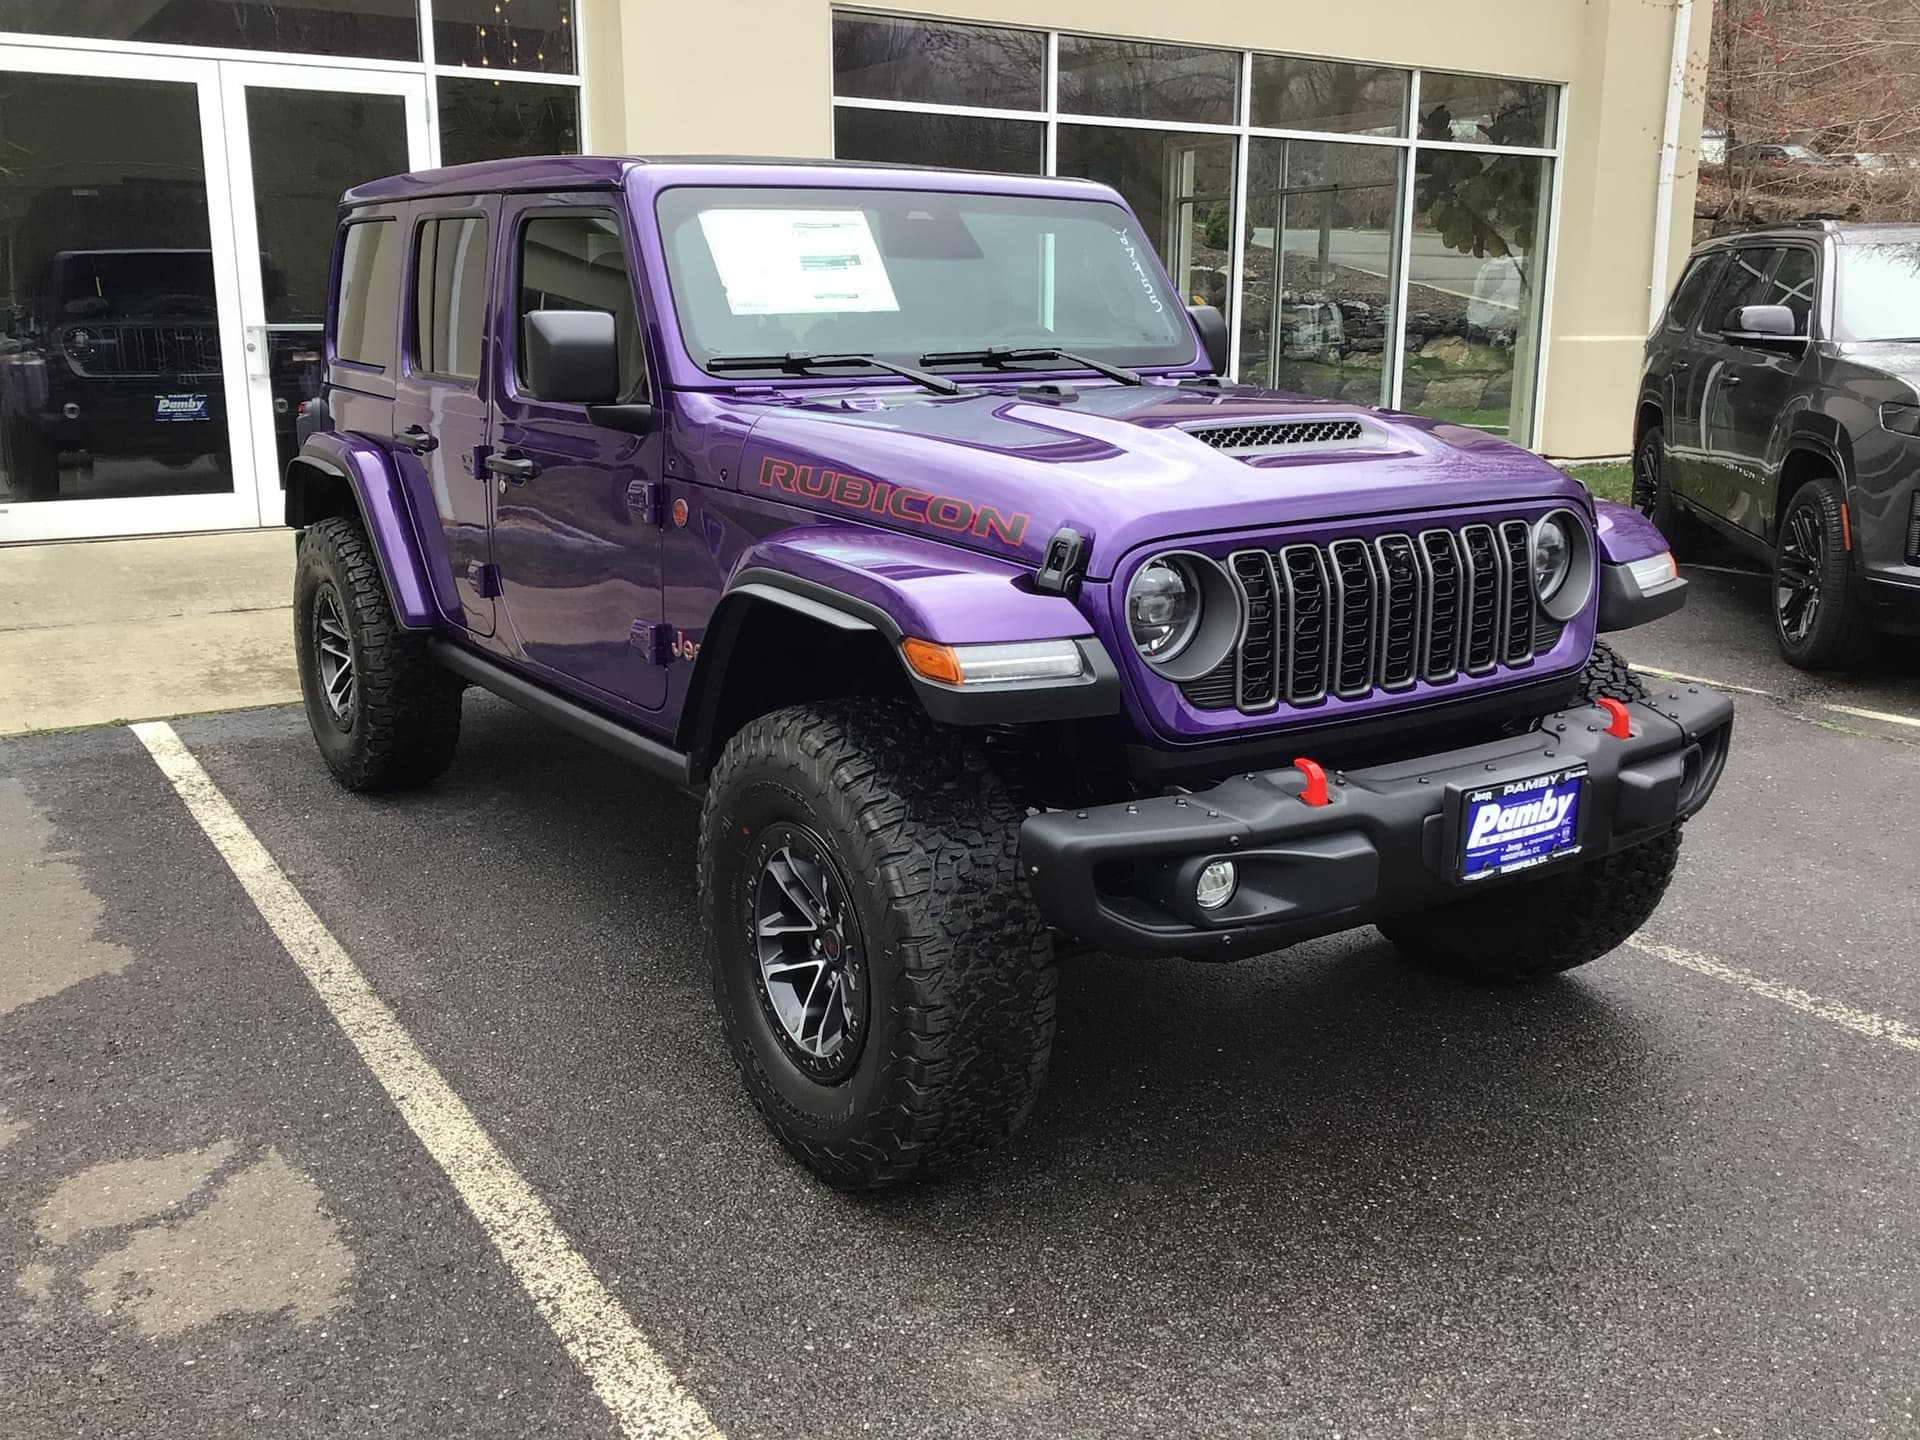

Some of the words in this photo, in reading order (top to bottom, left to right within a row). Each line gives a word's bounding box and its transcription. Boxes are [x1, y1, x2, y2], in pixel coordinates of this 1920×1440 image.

[157, 398, 206, 412] Pamby
[759, 456, 1031, 546] RUBICON
[1503, 774, 1560, 796] PAMBY
[1467, 789, 1576, 850] Pamby
